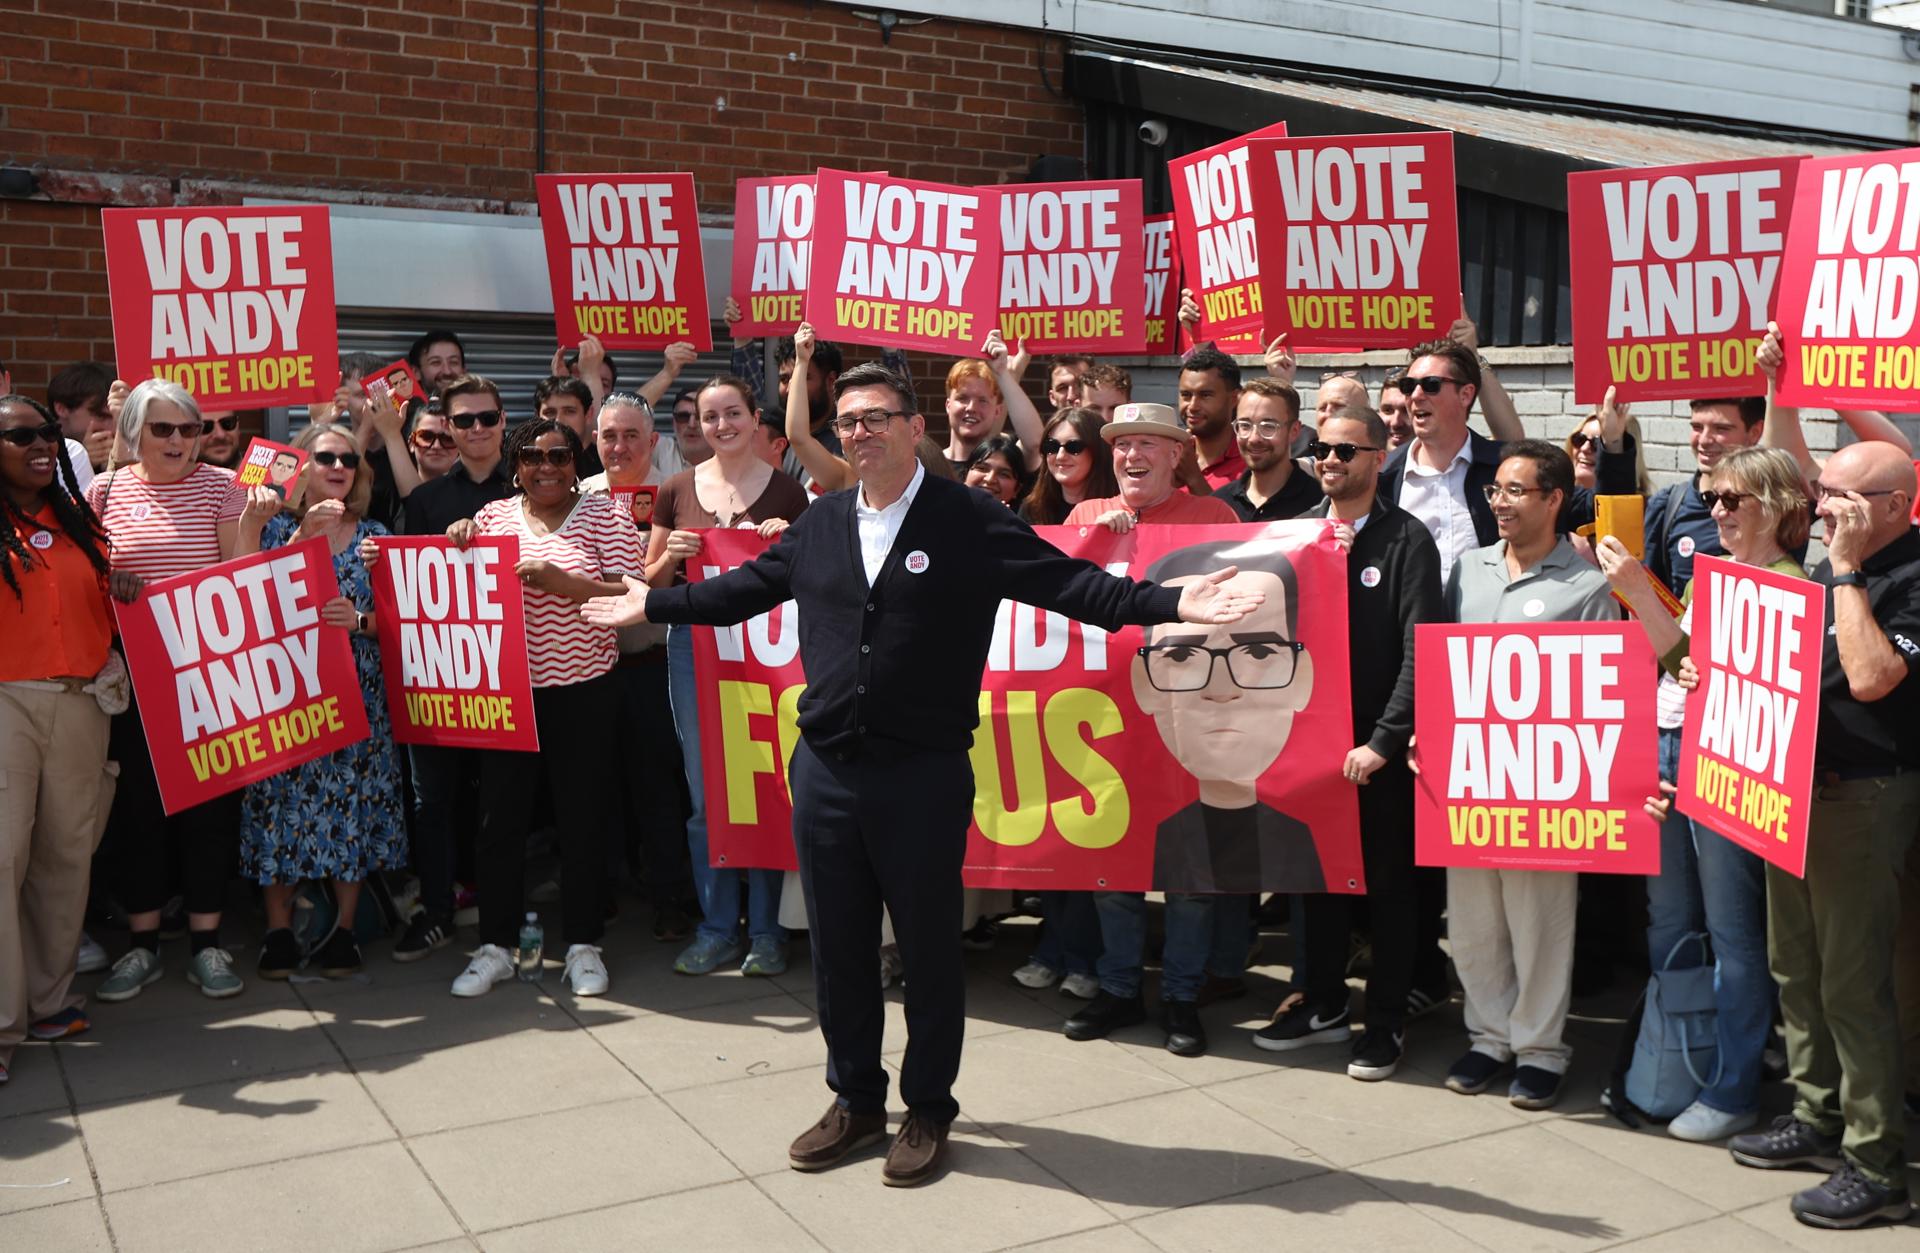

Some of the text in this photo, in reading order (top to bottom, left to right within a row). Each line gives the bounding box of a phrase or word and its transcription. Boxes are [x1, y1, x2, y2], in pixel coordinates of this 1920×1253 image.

[556, 183, 680, 245] VOTE
[756, 183, 816, 240] VO
[844, 180, 979, 252] VOTE
[1184, 146, 1253, 228] VOT
[1275, 146, 1429, 222] VOTE
[1601, 169, 1783, 262] VOTE
[1817, 162, 1920, 255] VOT
[137, 216, 307, 291] VOTE
[1000, 189, 1121, 252] VOTE
[1197, 217, 1259, 289] AND
[571, 247, 679, 302] ANDY
[836, 240, 975, 307] ANDY
[1000, 251, 1120, 308] ANDY
[1286, 223, 1428, 290] ANDY
[151, 287, 306, 360] ANDY
[574, 305, 690, 336] VOTE HOPE
[751, 295, 803, 323] VOTE
[835, 298, 974, 341] VOTE HOPE
[1000, 308, 1124, 341] VOTE HOPE
[1204, 286, 1248, 324] VOTE
[1287, 296, 1355, 329] VOTE
[1362, 296, 1435, 330] HOPE
[1607, 256, 1780, 339] ANDY
[1801, 256, 1920, 339] AND
[238, 355, 315, 392] HOPE
[1607, 338, 1764, 383] VOTE HOP
[1801, 344, 1920, 390] VOTE HO
[244, 463, 269, 477] VOTE
[247, 454, 274, 468] ANDY
[252, 444, 277, 458] VOTE
[388, 546, 504, 621] VOTE
[909, 554, 925, 563] VOTE
[909, 561, 925, 569] ANDY
[148, 552, 319, 669] VOTE
[1710, 570, 1806, 694] VOTE
[175, 627, 322, 744] ANDY
[400, 623, 503, 691] ANDY
[1446, 634, 1625, 720] VOTE
[187, 724, 267, 783] VOTE
[268, 696, 344, 754] HOPE
[405, 692, 516, 732] VOTE HOPE
[1698, 666, 1799, 785] ANDY
[1447, 723, 1622, 802] ANDY
[1447, 805, 1627, 852] VOTE HOPE
[1695, 754, 1740, 816] VOTE
[1739, 776, 1791, 844] HOPE
